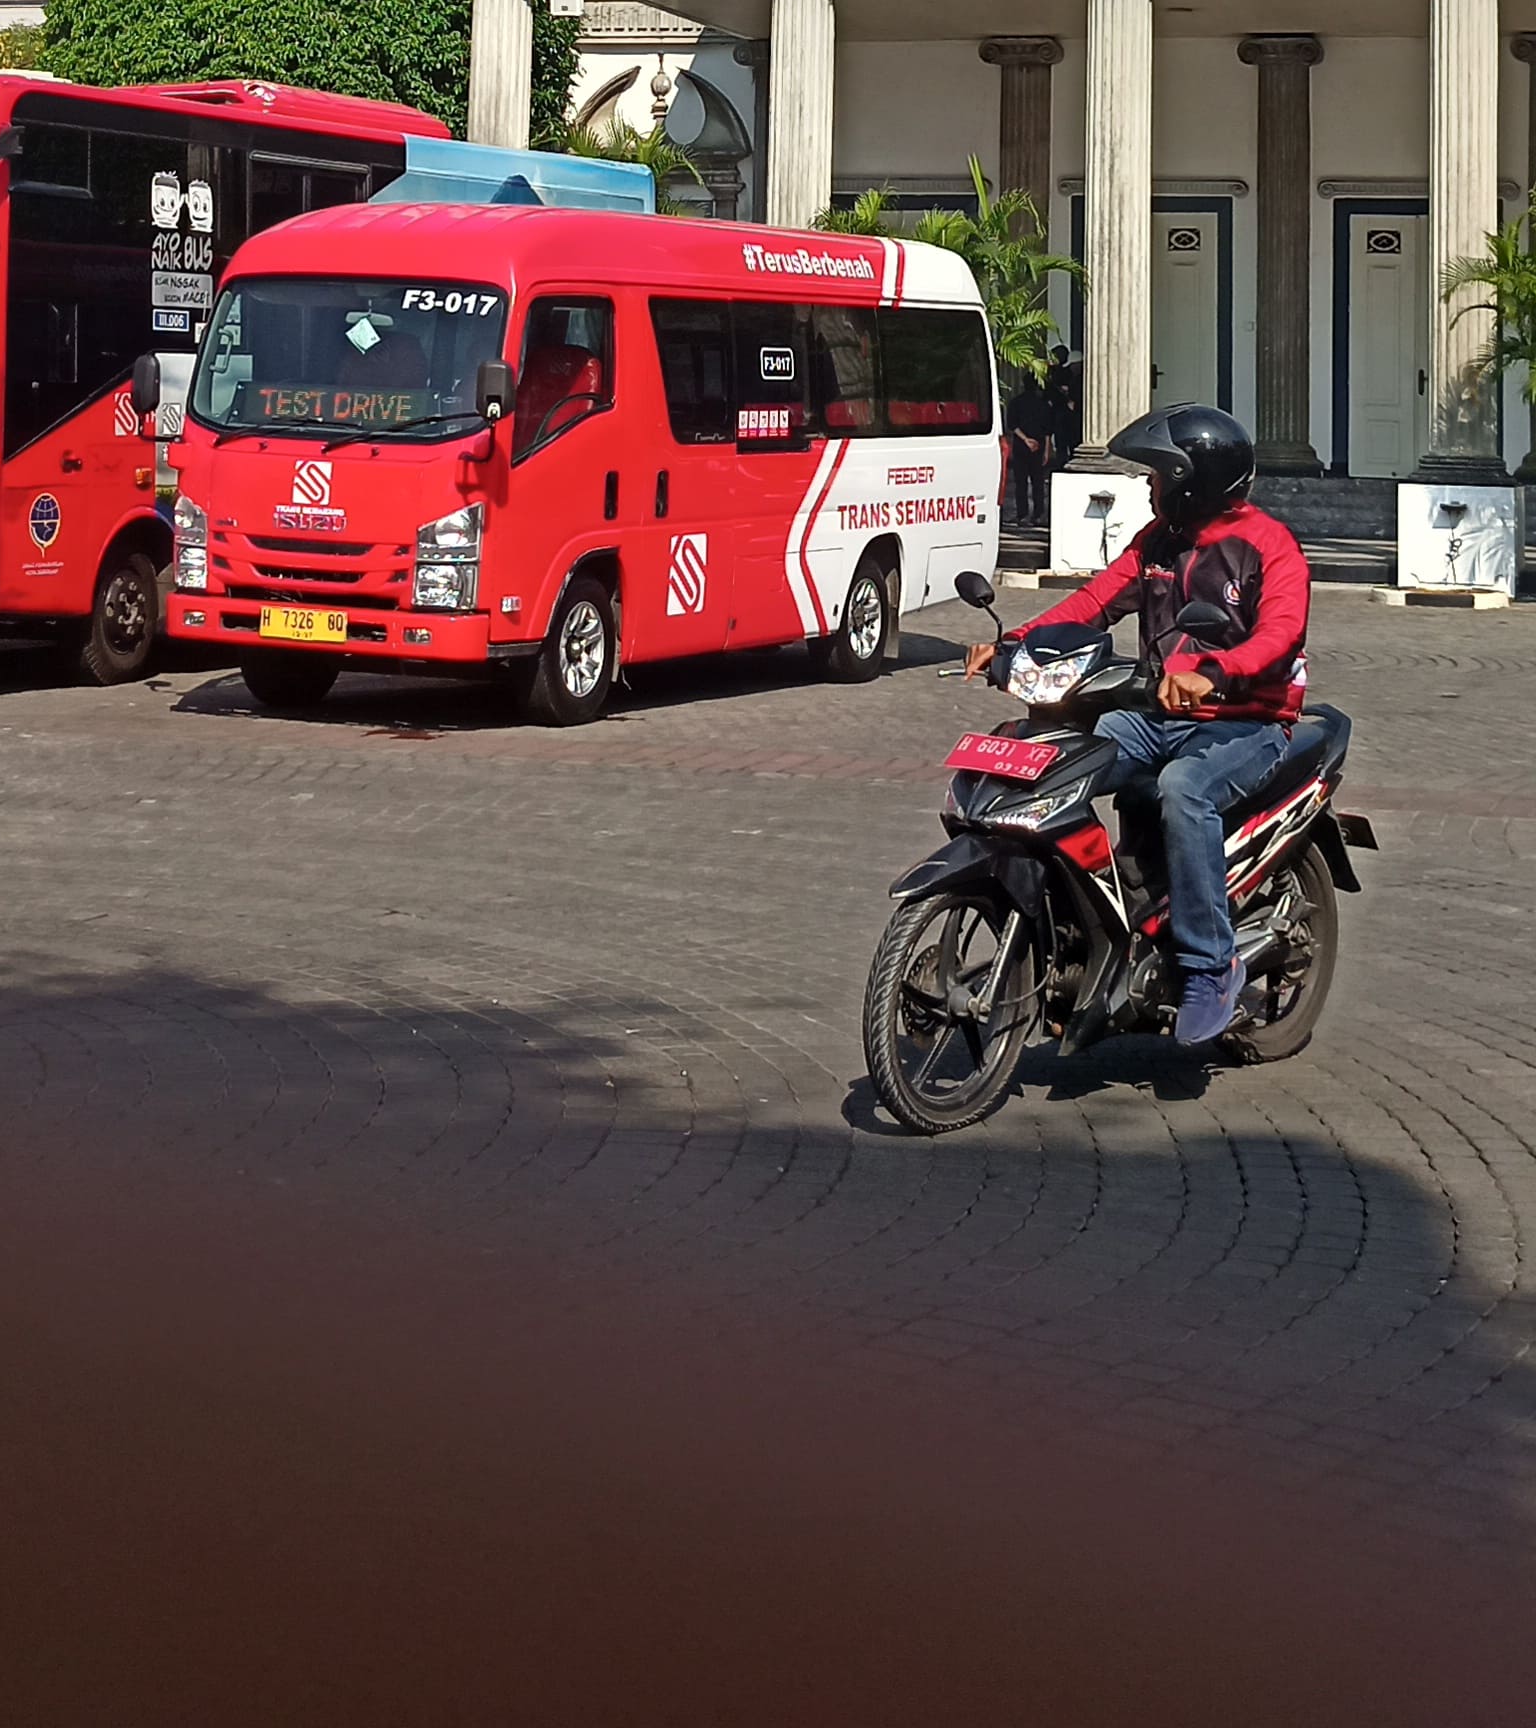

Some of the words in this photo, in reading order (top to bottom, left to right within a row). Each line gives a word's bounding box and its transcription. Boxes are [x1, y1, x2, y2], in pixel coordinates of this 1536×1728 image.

[151, 232, 181, 252] AYO
[151, 250, 183, 270] NAIK
[184, 235, 213, 271] BUS
[742, 243, 876, 280] #TerusBerbenah
[401, 289, 499, 316] F3-017
[764, 356, 791, 372] F3-017
[258, 387, 327, 417] TEST
[333, 391, 413, 421] DRIVE
[886, 466, 935, 485] FEEDER
[272, 512, 348, 532] ISUZU
[837, 501, 891, 530] TRANS
[895, 495, 976, 526] SEMARANG
[262, 608, 272, 627] H
[282, 610, 314, 630] 7326
[956, 735, 974, 752] H
[976, 738, 1017, 758] 6031
